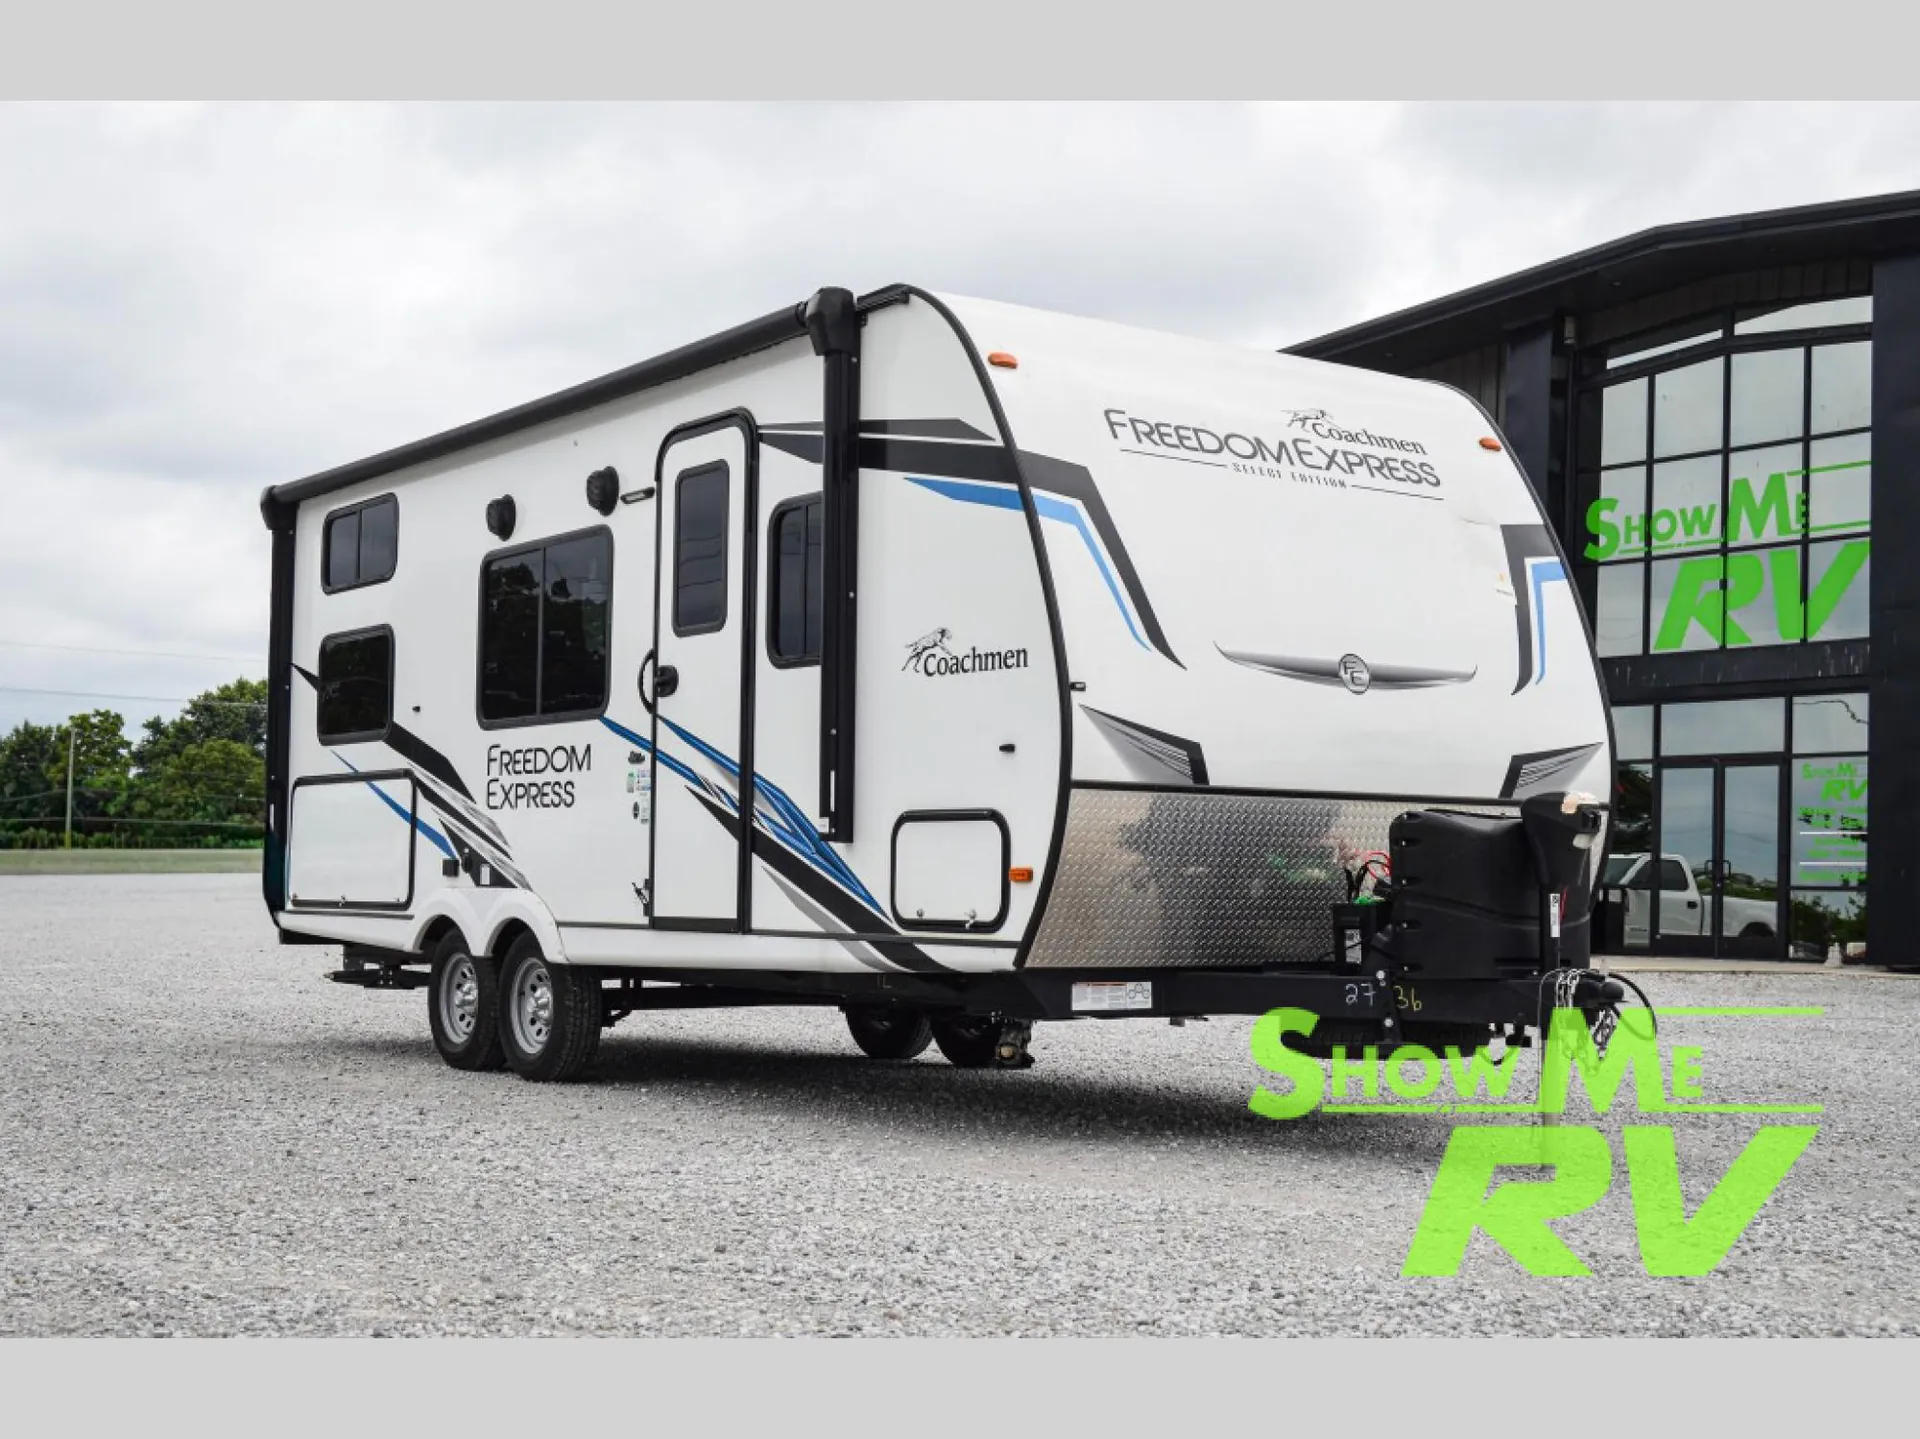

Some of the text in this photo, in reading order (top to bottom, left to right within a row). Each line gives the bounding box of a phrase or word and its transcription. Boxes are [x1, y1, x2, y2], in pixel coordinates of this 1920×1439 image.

[1312, 422, 1427, 455] Coachmen
[1654, 540, 1870, 650] RV
[924, 646, 1028, 677] Coachmen
[487, 744, 591, 776] FREEDOM
[487, 778, 575, 809] EXPRESS
[1821, 779, 1868, 800] RV
[1345, 982, 1422, 1012] 27 36
